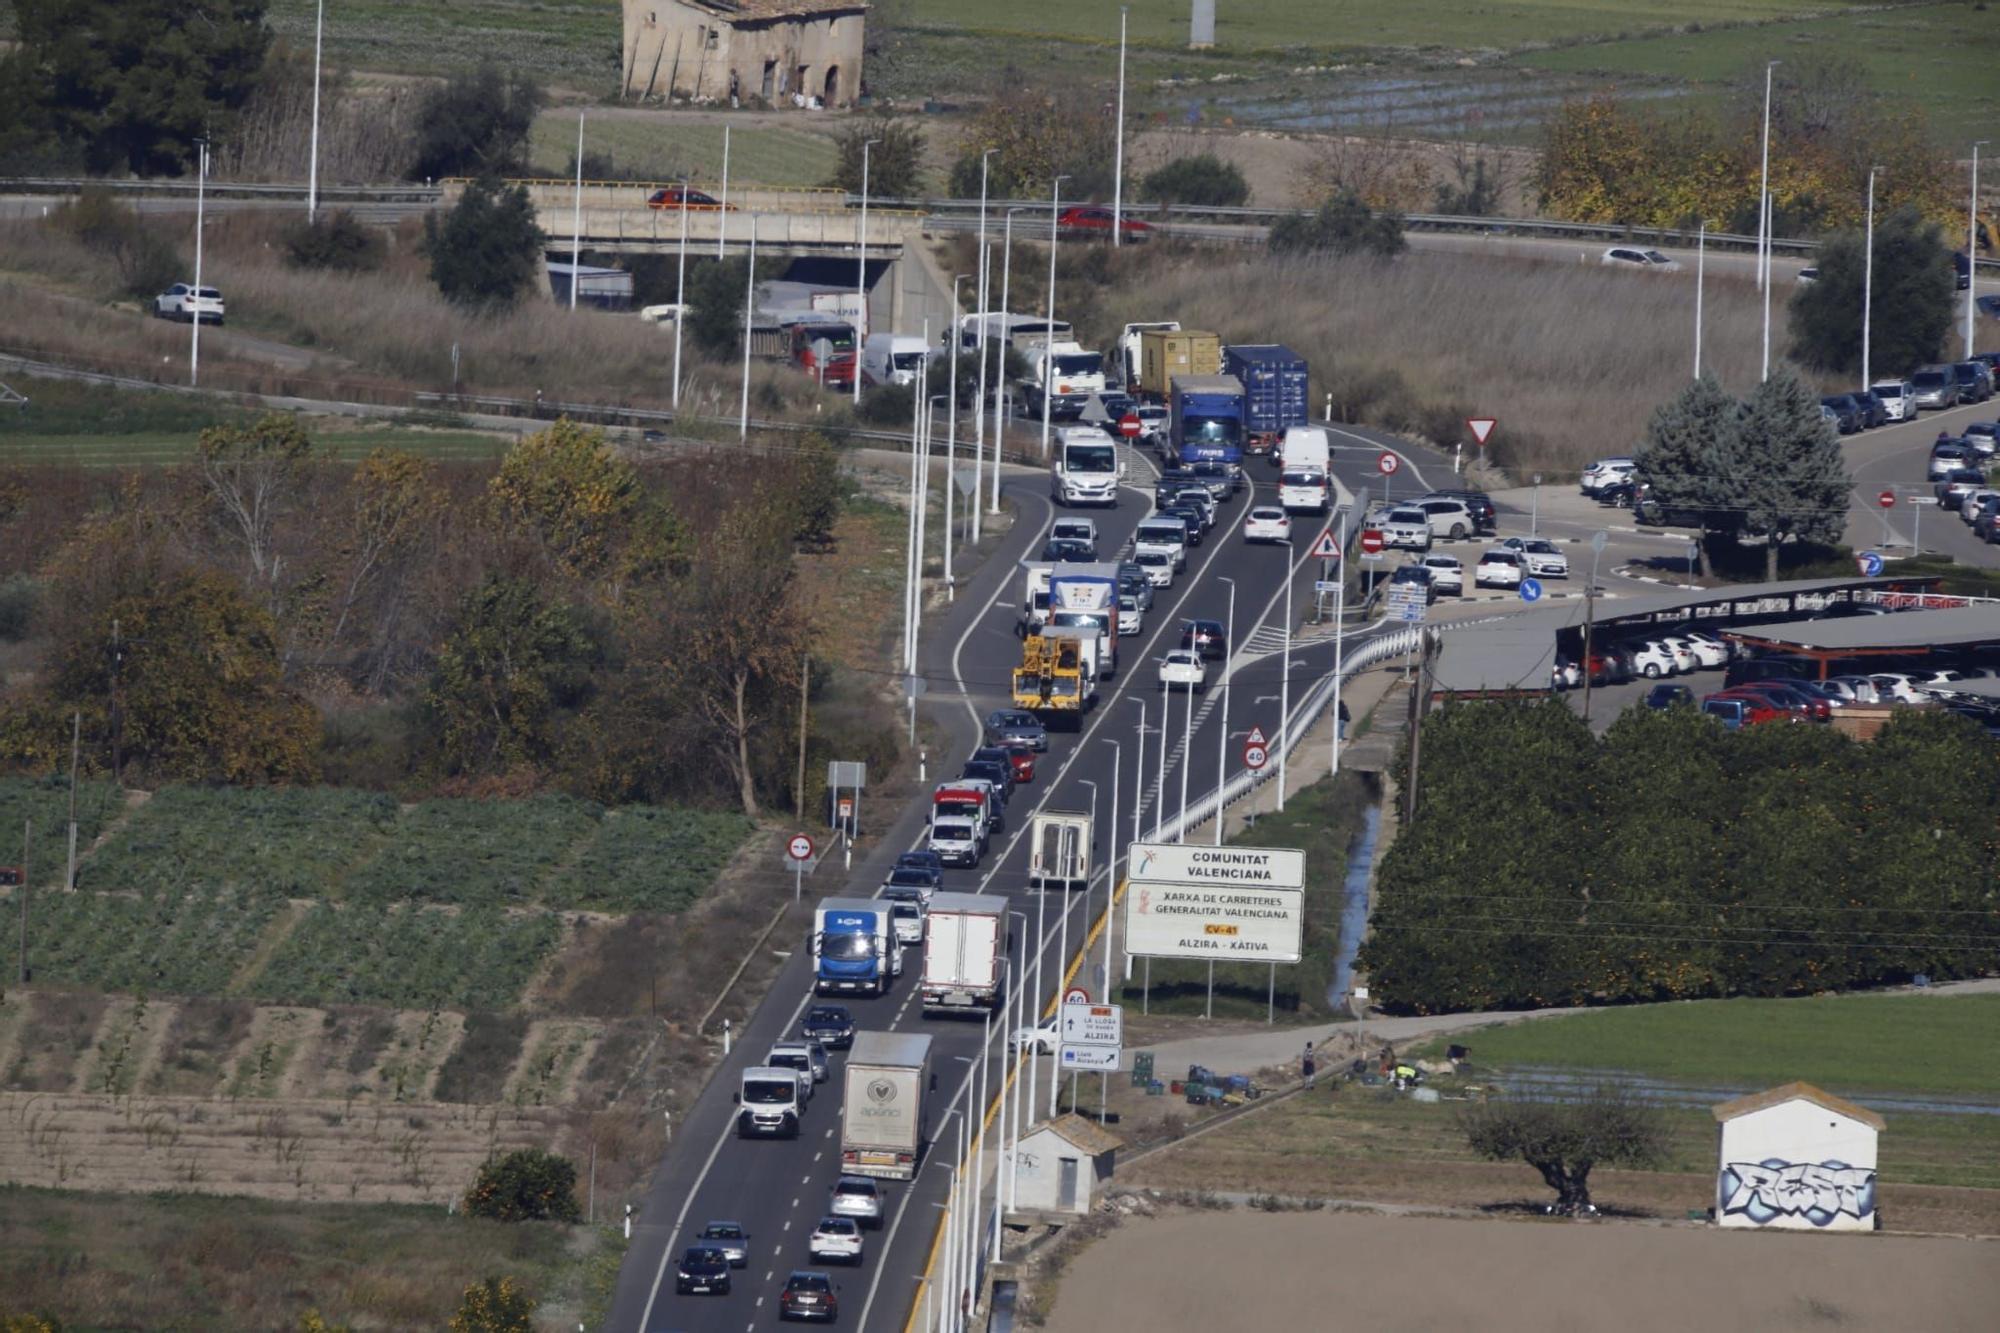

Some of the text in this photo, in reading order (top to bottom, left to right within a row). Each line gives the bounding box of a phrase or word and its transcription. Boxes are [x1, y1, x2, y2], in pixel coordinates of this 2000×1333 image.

[1248, 752, 1263, 761] 40
[1192, 852, 1269, 865] COMUNITAT
[1187, 866, 1272, 880] VALENCIANA
[1163, 892, 1283, 906] XARXA DE CARRETERES
[1155, 904, 1288, 919] GENERALITAT VALENCIANA
[1205, 924, 1238, 935] CV-41
[1179, 938, 1219, 949] ALZIRA
[1084, 1032, 1115, 1040] ALZIRA
